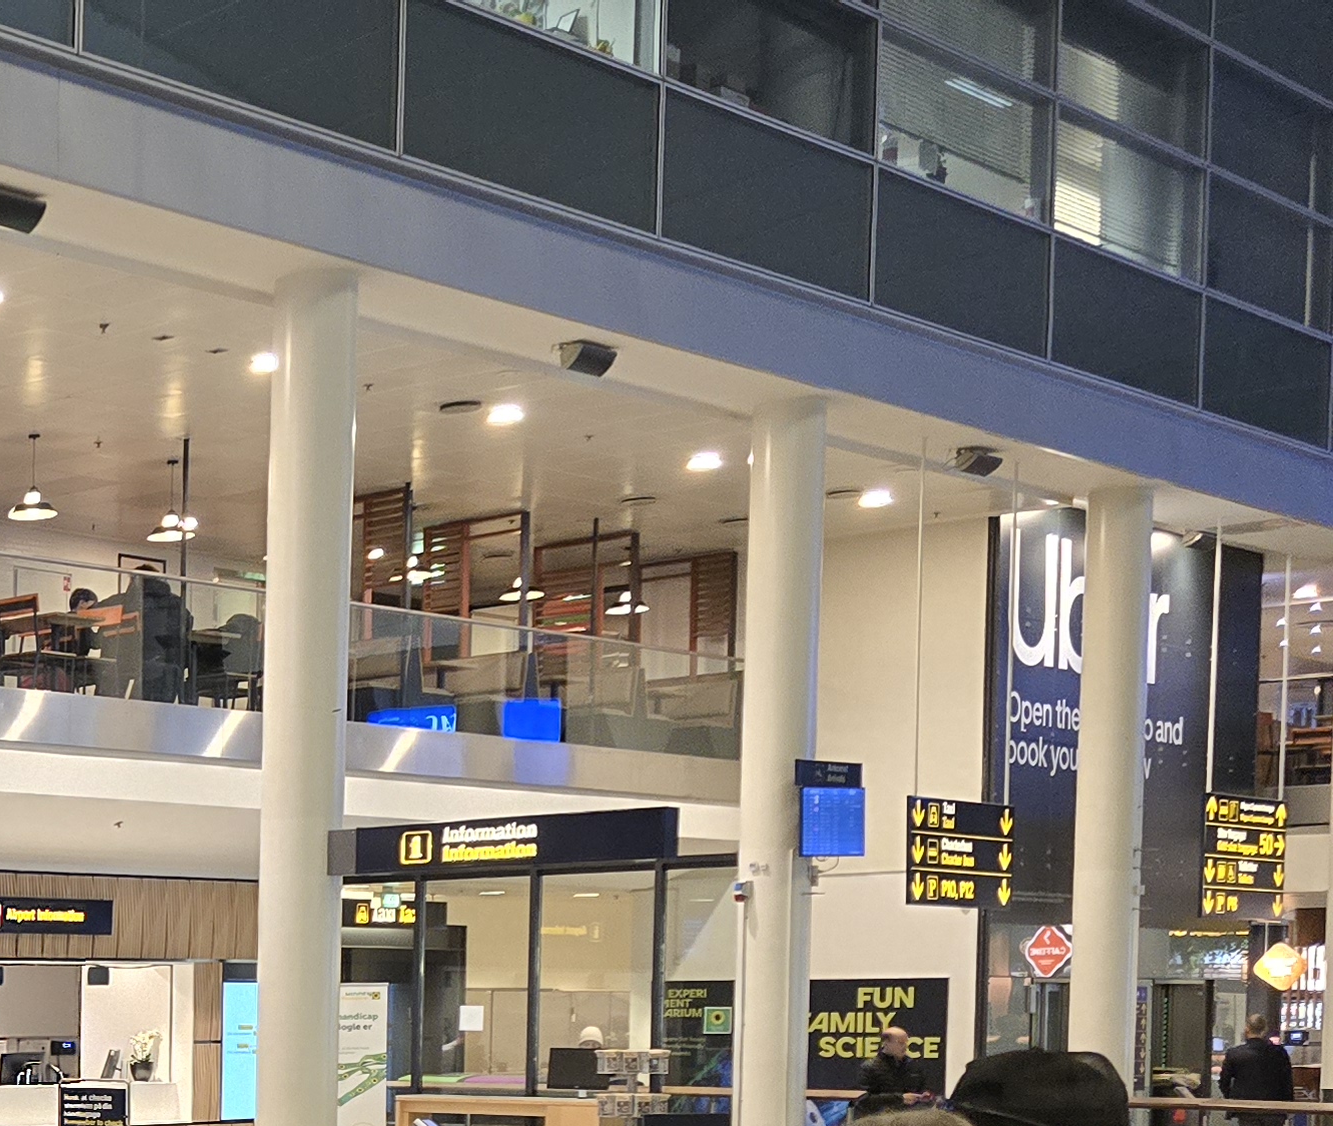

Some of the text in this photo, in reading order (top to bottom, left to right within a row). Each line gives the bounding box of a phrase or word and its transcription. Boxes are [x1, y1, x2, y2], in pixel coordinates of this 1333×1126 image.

[1156, 717, 1183, 745] and
[442, 822, 537, 844] Information
[442, 841, 537, 862] Information
[668, 989, 708, 998] EXPERI
[858, 987, 914, 1008] FUN
[808, 1012, 896, 1033] AMILY
[819, 1036, 941, 1059] SCIECE
